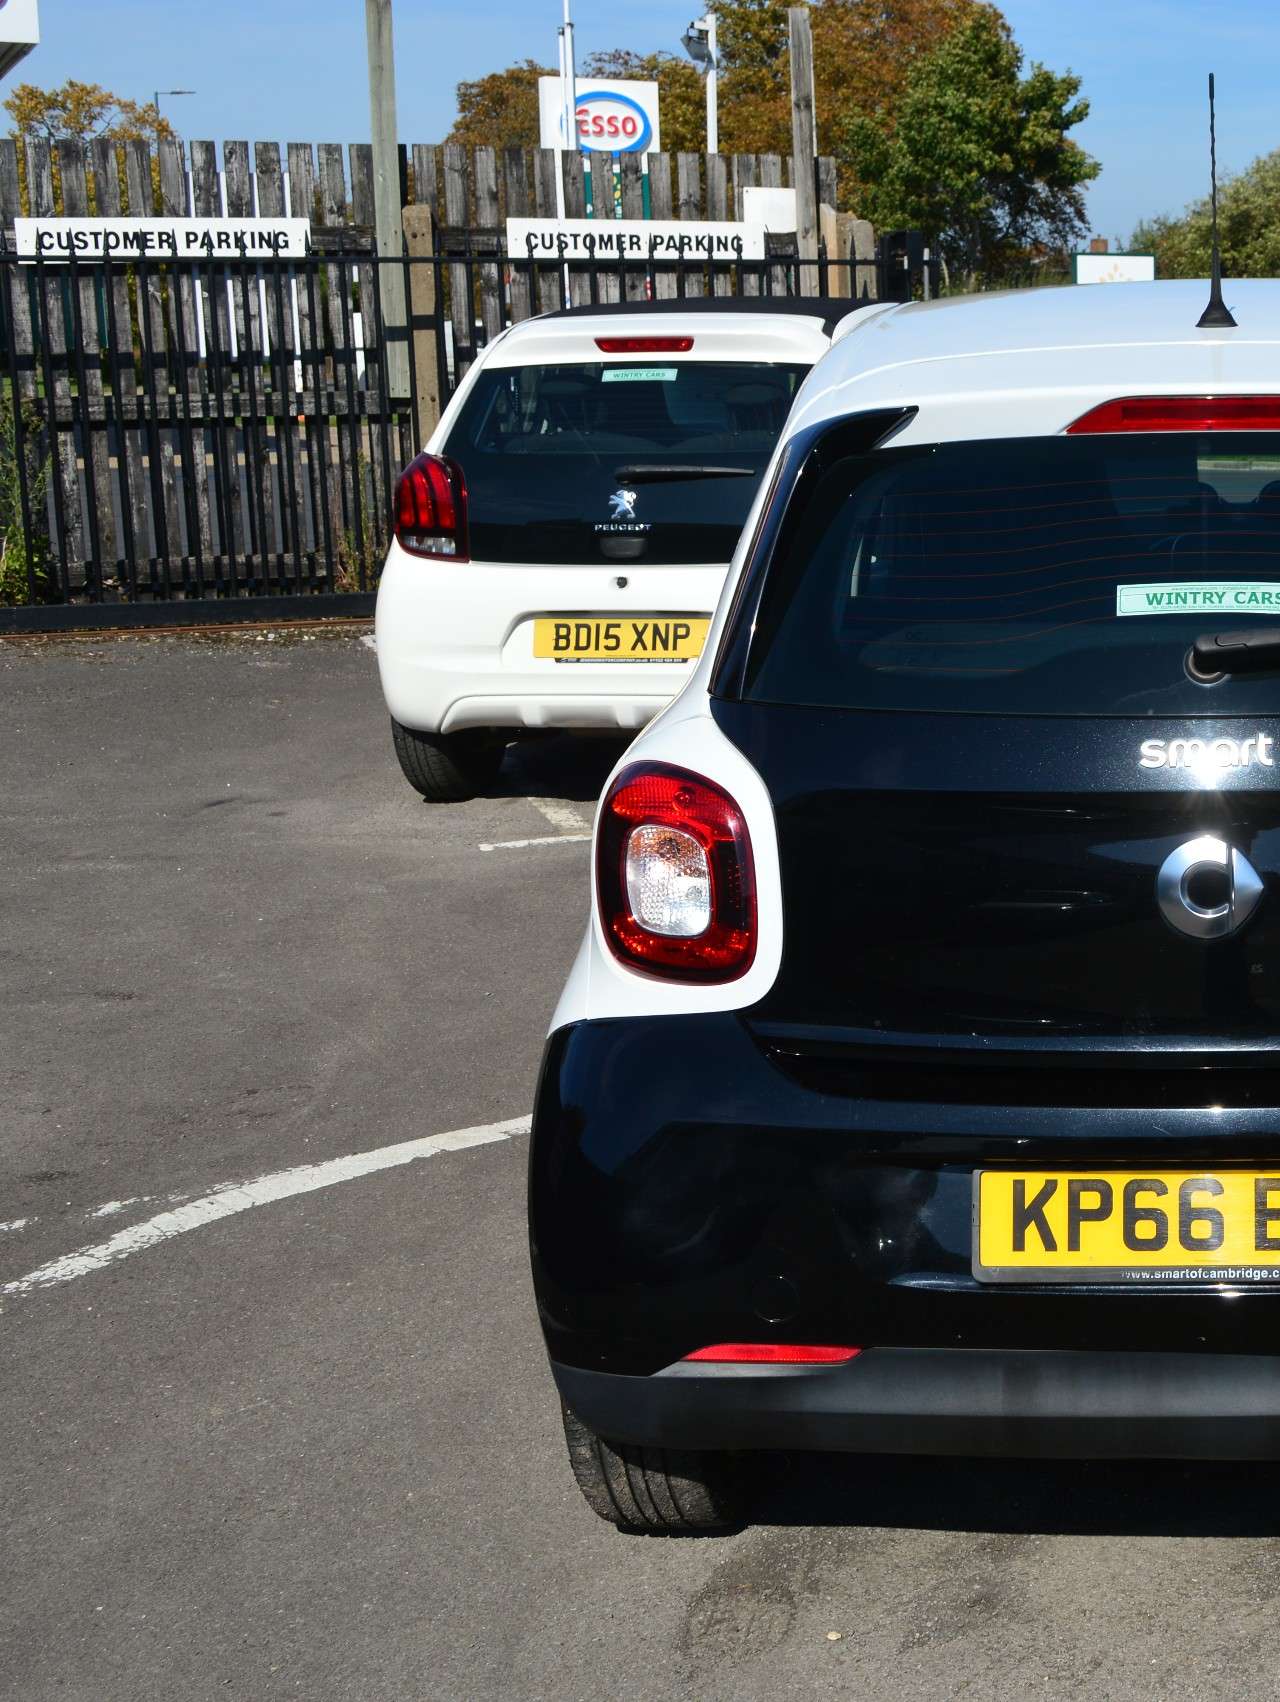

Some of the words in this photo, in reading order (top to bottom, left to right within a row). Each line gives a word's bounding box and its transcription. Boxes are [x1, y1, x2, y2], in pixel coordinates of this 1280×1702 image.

[40, 231, 172, 249] CUSTOMER
[185, 231, 290, 249] PARKING
[525, 232, 641, 251] CUSTOMER
[653, 234, 743, 252] PARKING
[594, 523, 652, 531] PEUGEOT
[1145, 591, 1226, 606] WINTRY
[553, 623, 621, 651] BD15
[630, 623, 690, 651] XNP
[1138, 732, 1274, 768] smart
[1012, 1177, 1225, 1252] KP66
